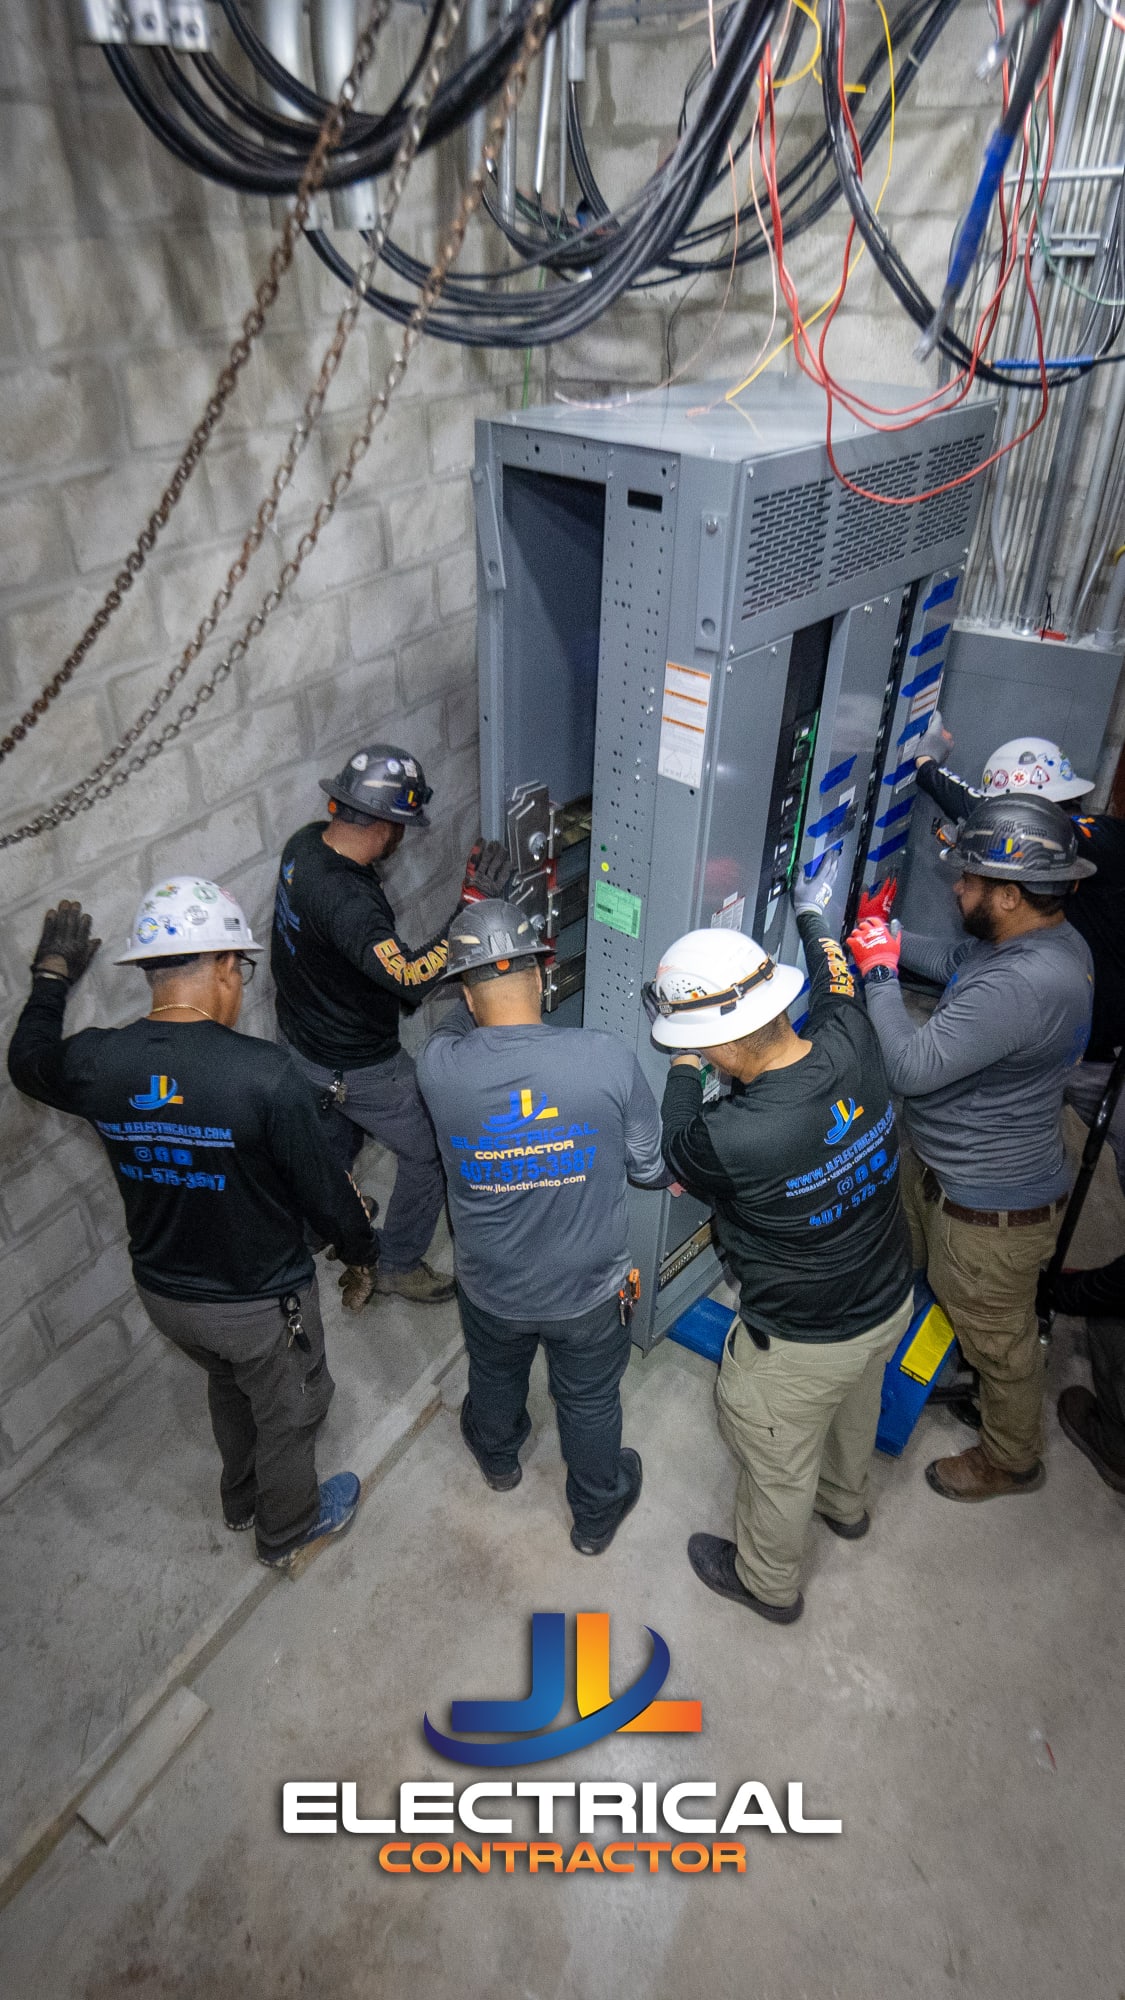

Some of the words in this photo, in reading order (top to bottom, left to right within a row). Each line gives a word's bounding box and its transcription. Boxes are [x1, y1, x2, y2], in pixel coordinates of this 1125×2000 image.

[450, 1122, 599, 1150] ELECTRICAL
[474, 1140, 574, 1160] CONTRACTOR
[460, 1145, 597, 1183] 407-575-3587
[470, 1174, 587, 1194] www.jlelectricalco.com
